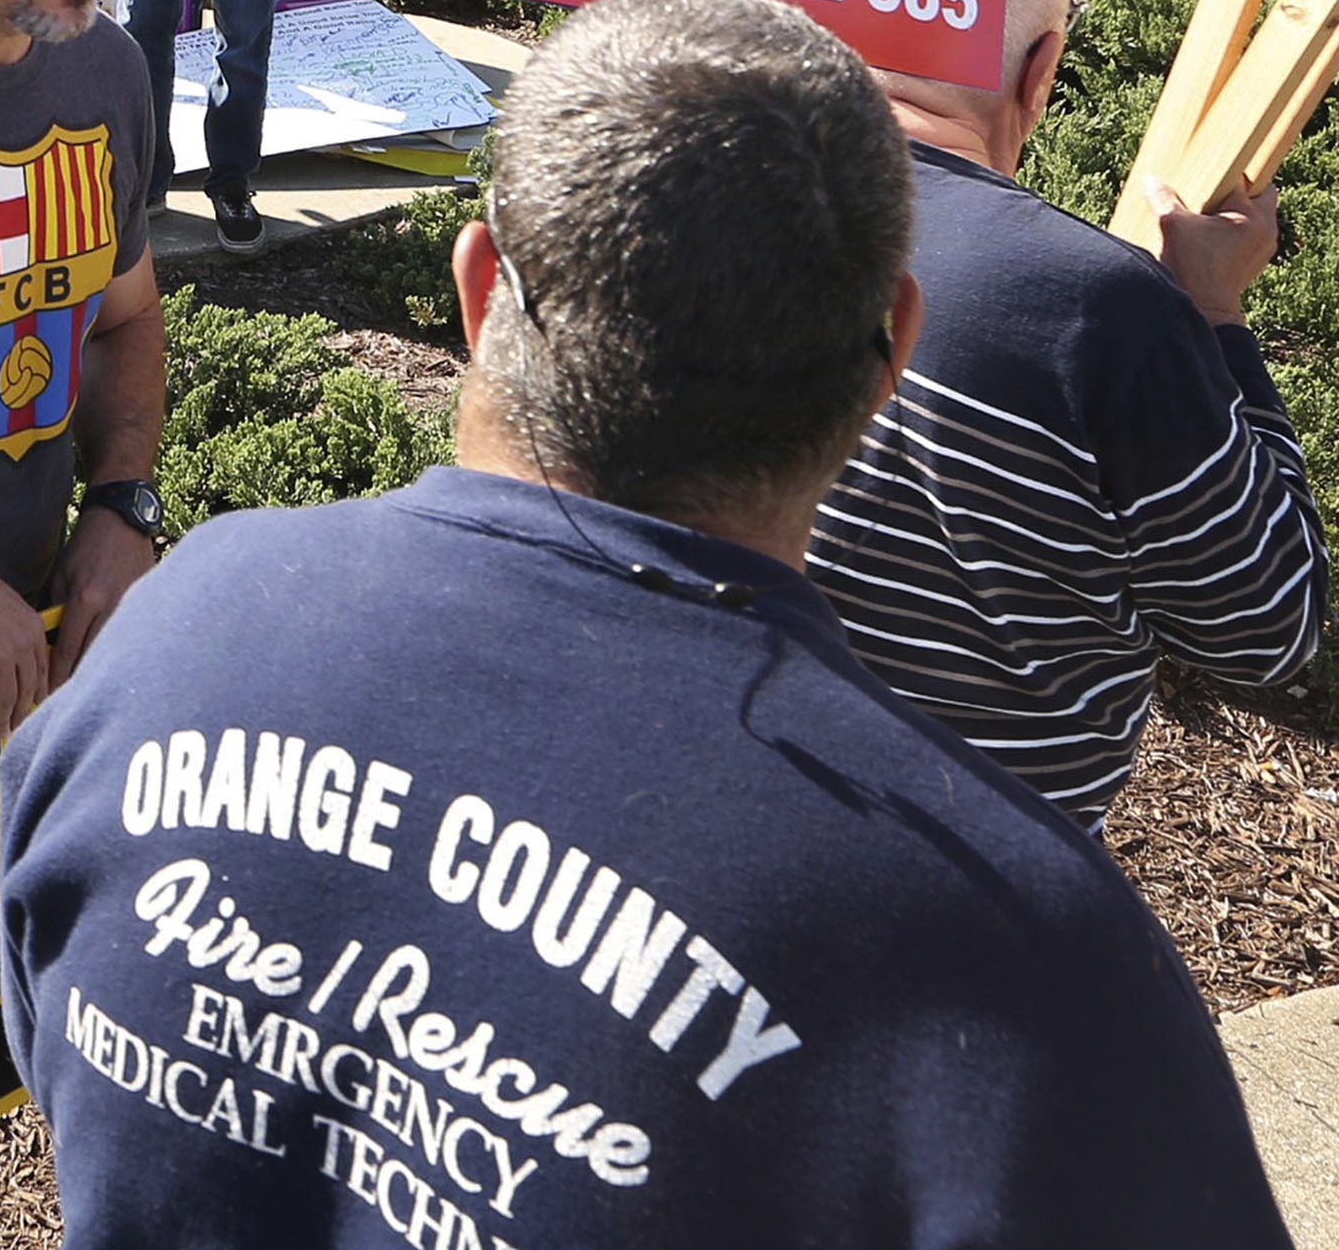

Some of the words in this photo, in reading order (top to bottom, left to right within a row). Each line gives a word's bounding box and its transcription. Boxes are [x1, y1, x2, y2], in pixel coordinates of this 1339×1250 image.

[122, 728, 414, 871] ORANGE
[427, 794, 802, 1102] COUNTY
[64, 986, 288, 1158] MEDICAL
[183, 983, 539, 1219] EMRGENCY
